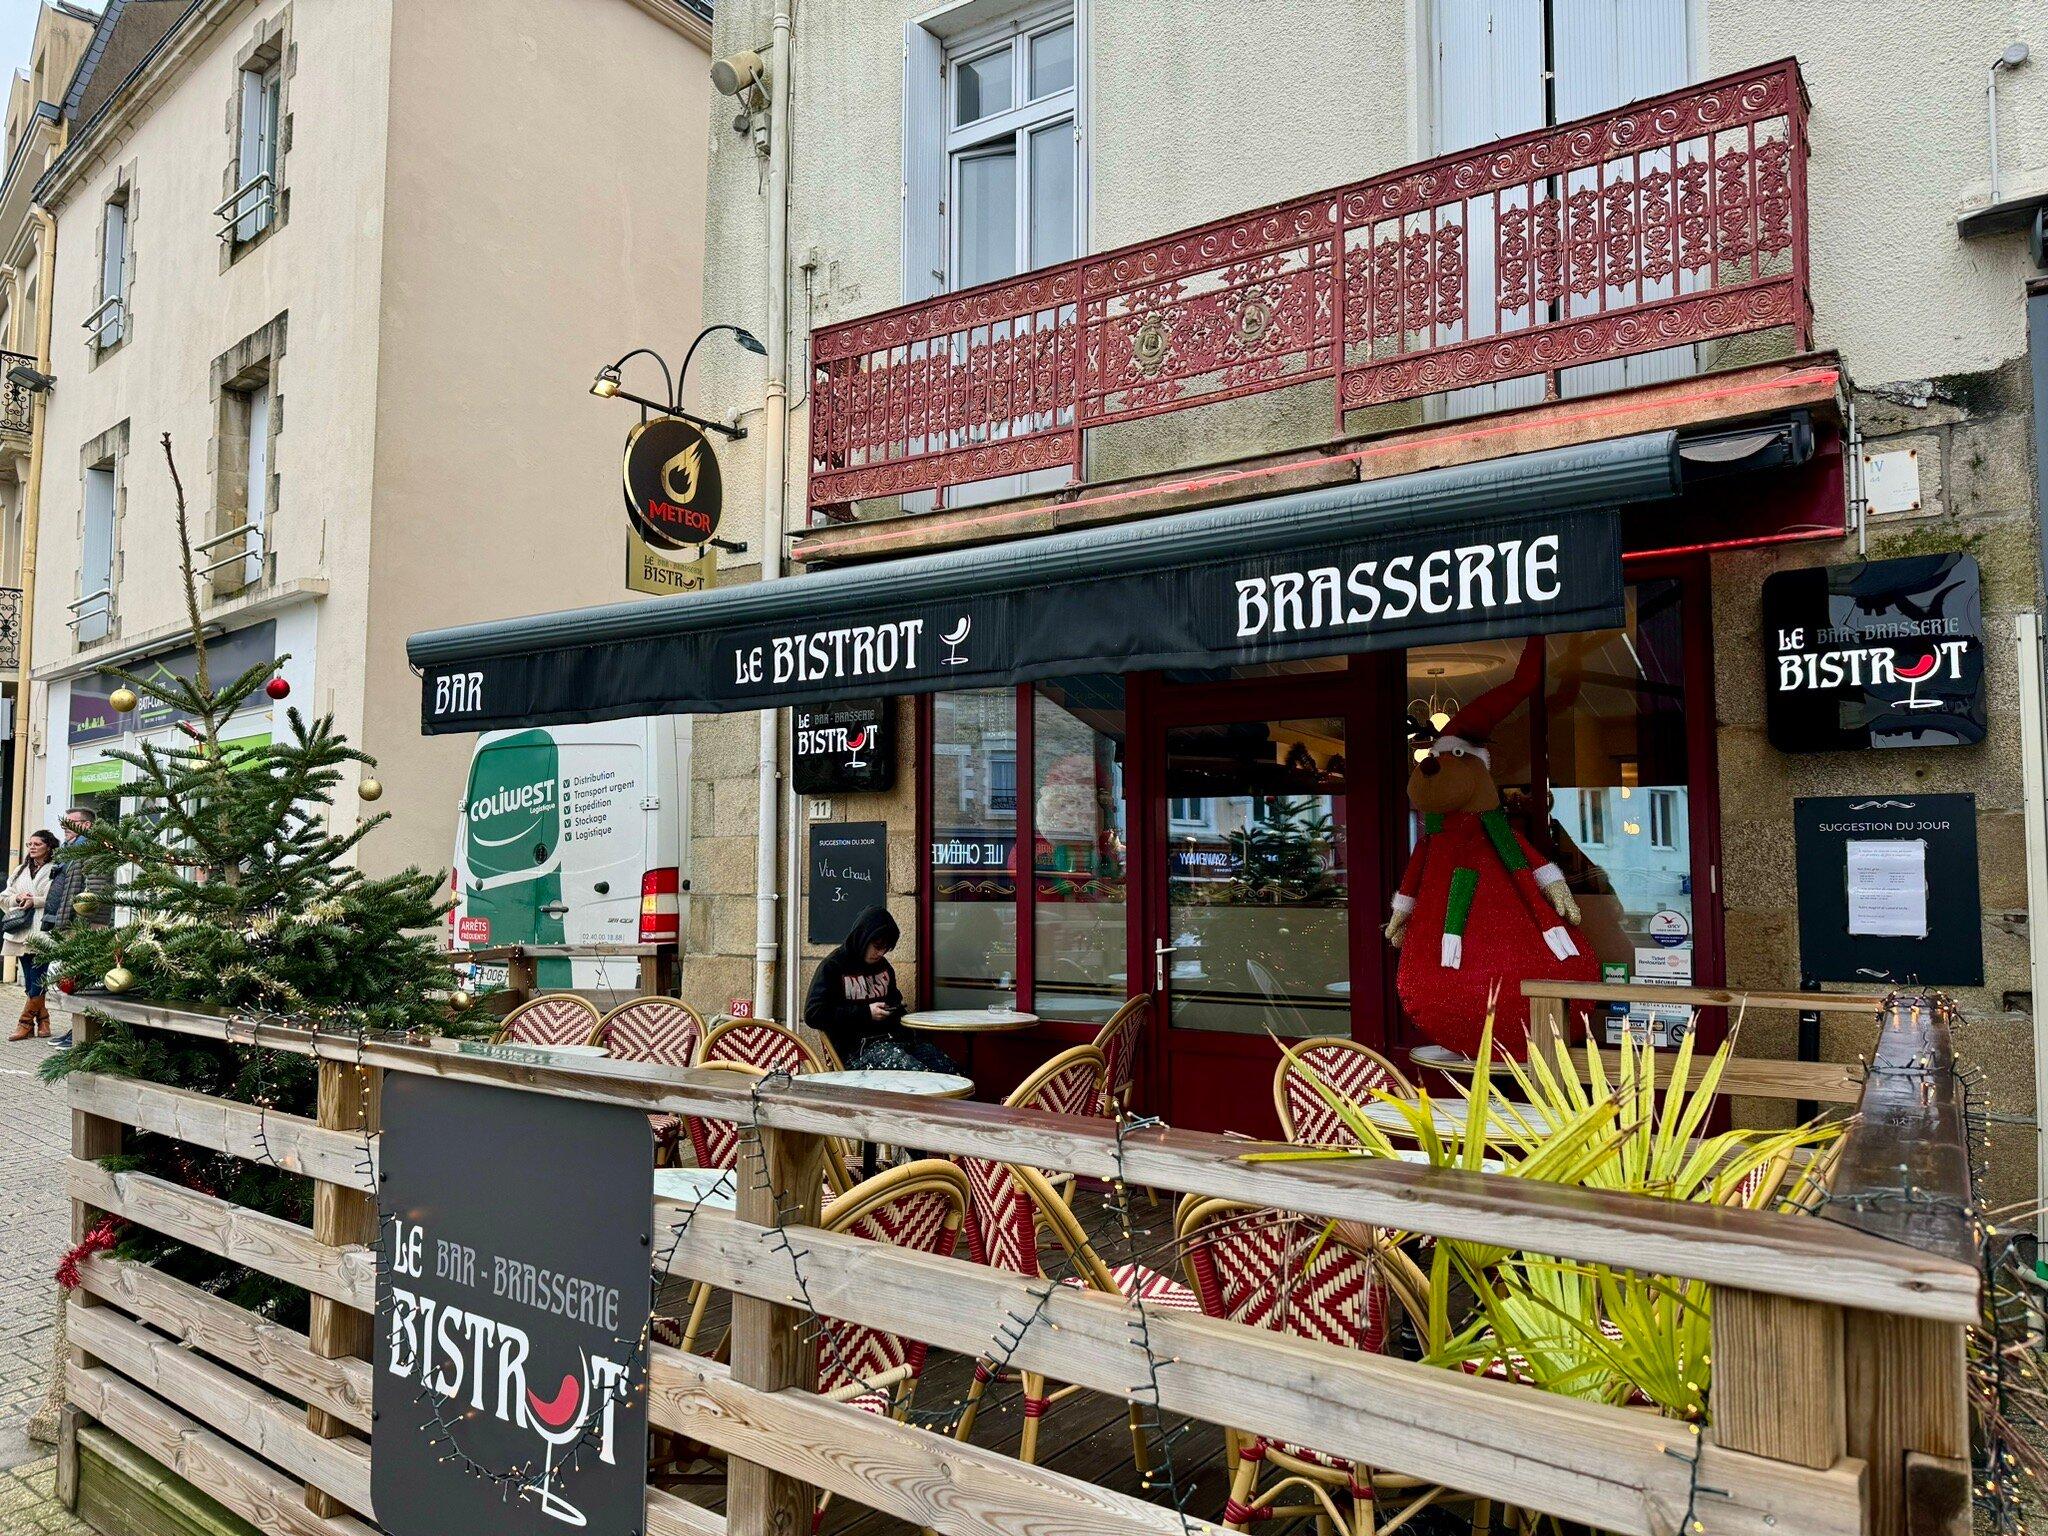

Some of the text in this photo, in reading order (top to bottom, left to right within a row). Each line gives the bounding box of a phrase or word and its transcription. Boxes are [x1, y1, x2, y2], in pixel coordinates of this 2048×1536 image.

[649, 499, 711, 533] METEOR
[1235, 534, 1561, 637] BRASSERIE
[1778, 627, 1805, 651] LE
[1816, 629, 1851, 645] BAR
[1864, 617, 1960, 641] BRASSERIE
[734, 619, 923, 685] LE BISTROT
[434, 671, 482, 715] BAR
[798, 713, 810, 729] LE
[814, 713, 829, 725] BAR
[834, 709, 875, 723] BRASSERIE
[573, 770, 616, 786] Distribution
[574, 779, 635, 800] Transport urgent
[574, 798, 612, 813] Expédition
[813, 801, 827, 816] 11
[574, 812, 607, 826] Stockage
[1819, 820, 1950, 832] SUGGESTION DU JOUR
[575, 825, 612, 841] Logistique
[818, 839, 851, 847] SUGGESTION
[818, 858, 837, 878] Vin
[460, 918, 487, 931] ARRÊTS
[460, 931, 487, 941] FRÉQUENTS
[733, 1002, 748, 1017] 29
[393, 1219, 424, 1278] LE
[435, 1238, 477, 1289] BAR
[493, 1254, 619, 1332] BRASSERIE
